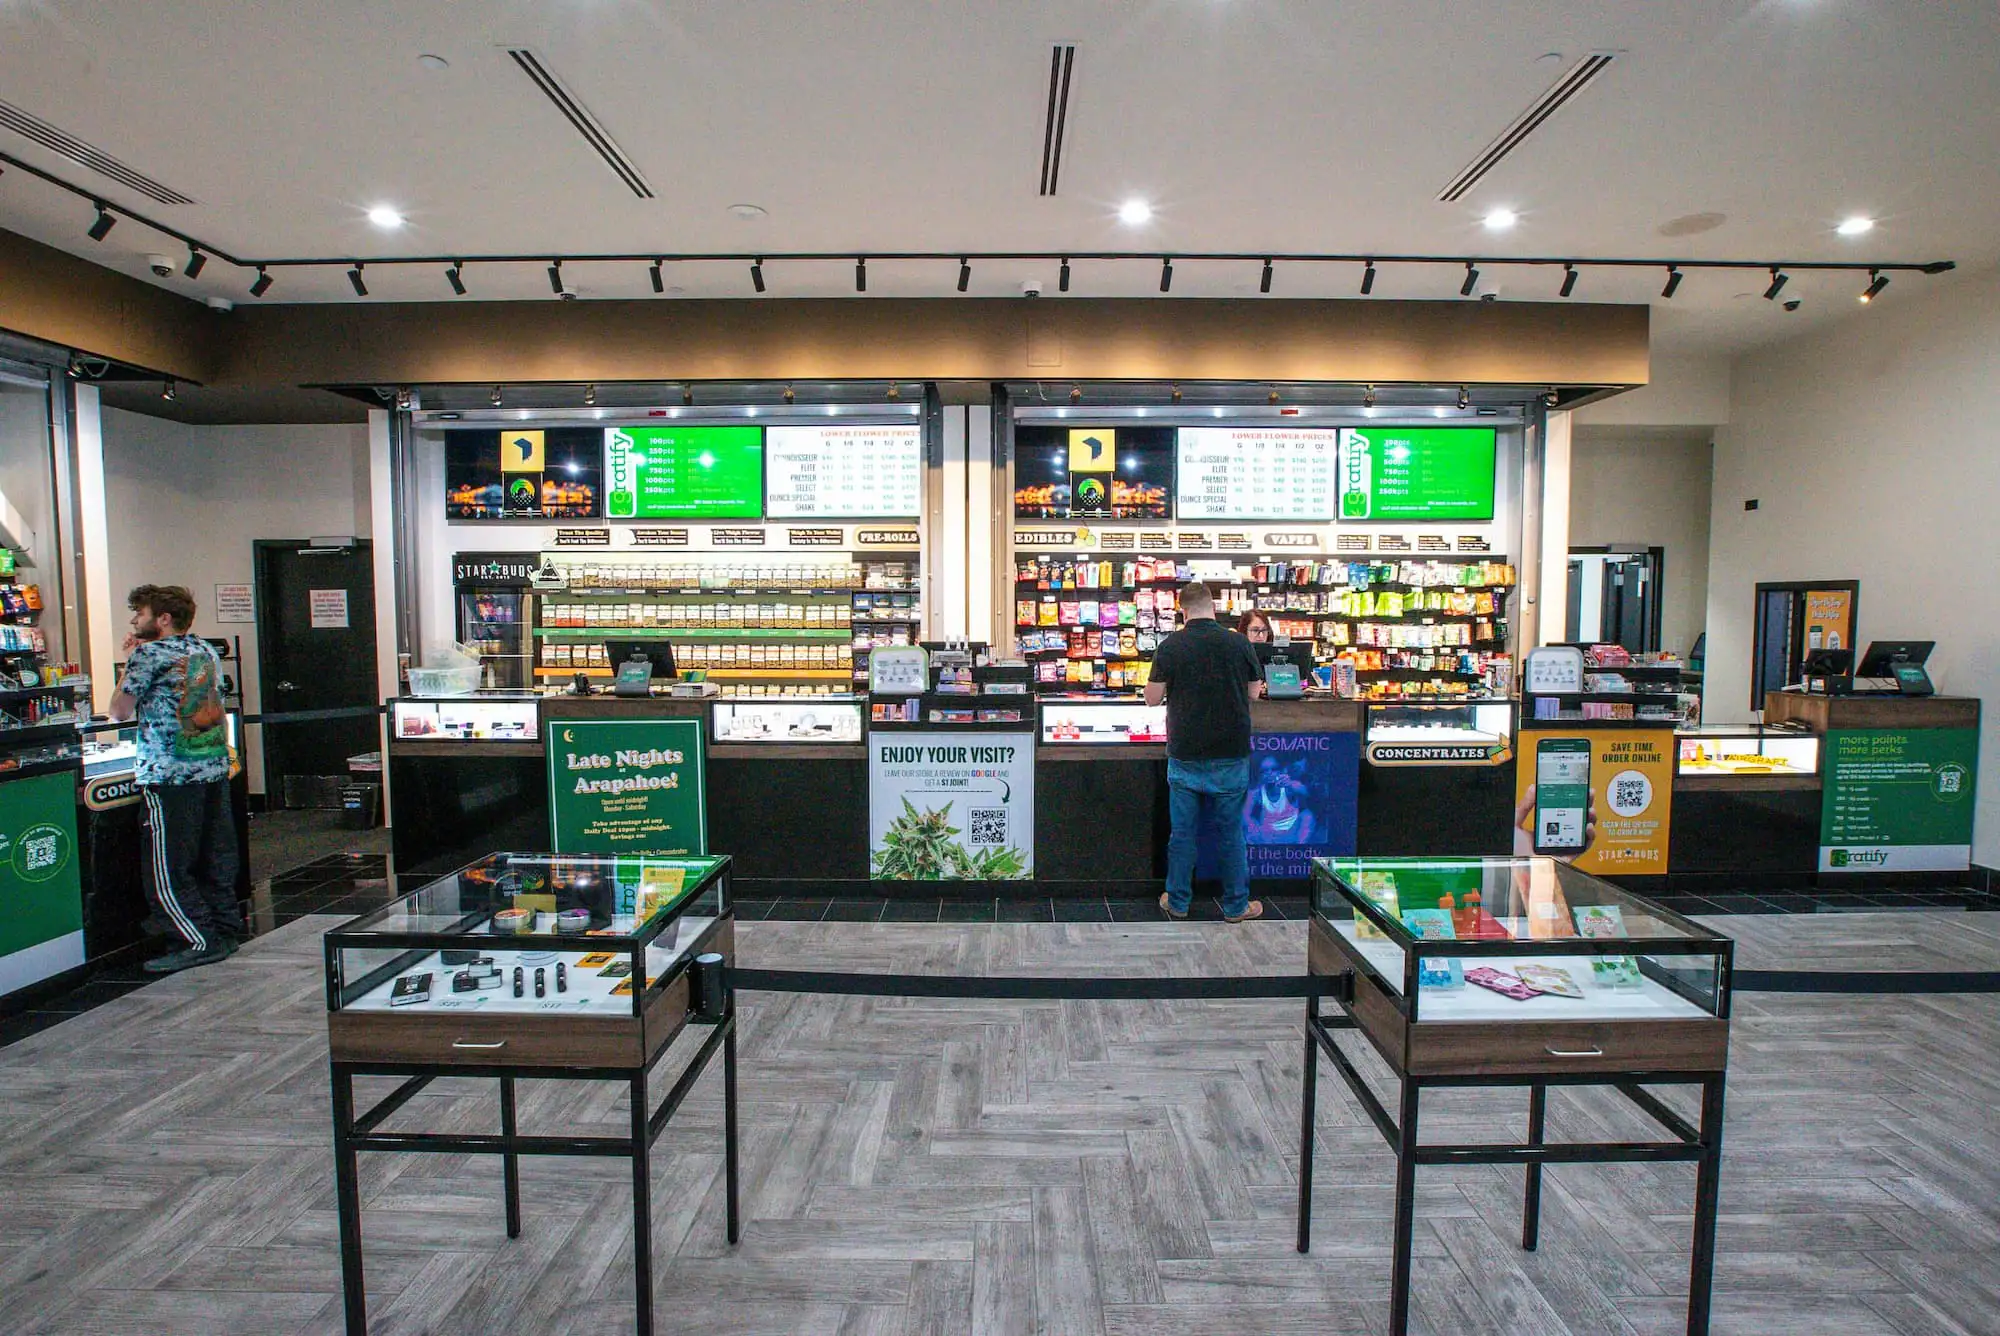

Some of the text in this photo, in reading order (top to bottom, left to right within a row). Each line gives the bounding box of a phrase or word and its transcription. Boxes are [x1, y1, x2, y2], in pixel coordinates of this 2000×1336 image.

[1206, 505, 1226, 513] SHAKE
[859, 532, 918, 542] PRE-ROLLS
[1014, 532, 1073, 544] EDIBLES
[1270, 534, 1314, 545] VAPES
[457, 563, 533, 579] STAR BUDS
[1839, 736, 1870, 745] more
[1610, 742, 1654, 752] SAVE TIME
[1838, 745, 1868, 755] more
[566, 748, 684, 770] Late Nights
[881, 746, 1016, 763] ENJOY YOUR VISIT?
[1375, 748, 1485, 759] CONCENTRATES
[1602, 753, 1662, 763] ORDER ONLINE
[884, 769, 901, 778] LEAVE
[901, 769, 915, 778] OUR
[939, 769, 960, 778] REVIEW
[961, 769, 971, 778] ON
[971, 769, 997, 778] GOOGLE
[997, 769, 1010, 778] AND
[573, 771, 679, 795] Arapahoe!
[924, 778, 936, 787] GET
[941, 778, 949, 787] $1
[949, 778, 970, 787] JOINT!
[1258, 847, 1281, 860] the
[1598, 849, 1623, 862] STAR
[1261, 862, 1284, 876] the
